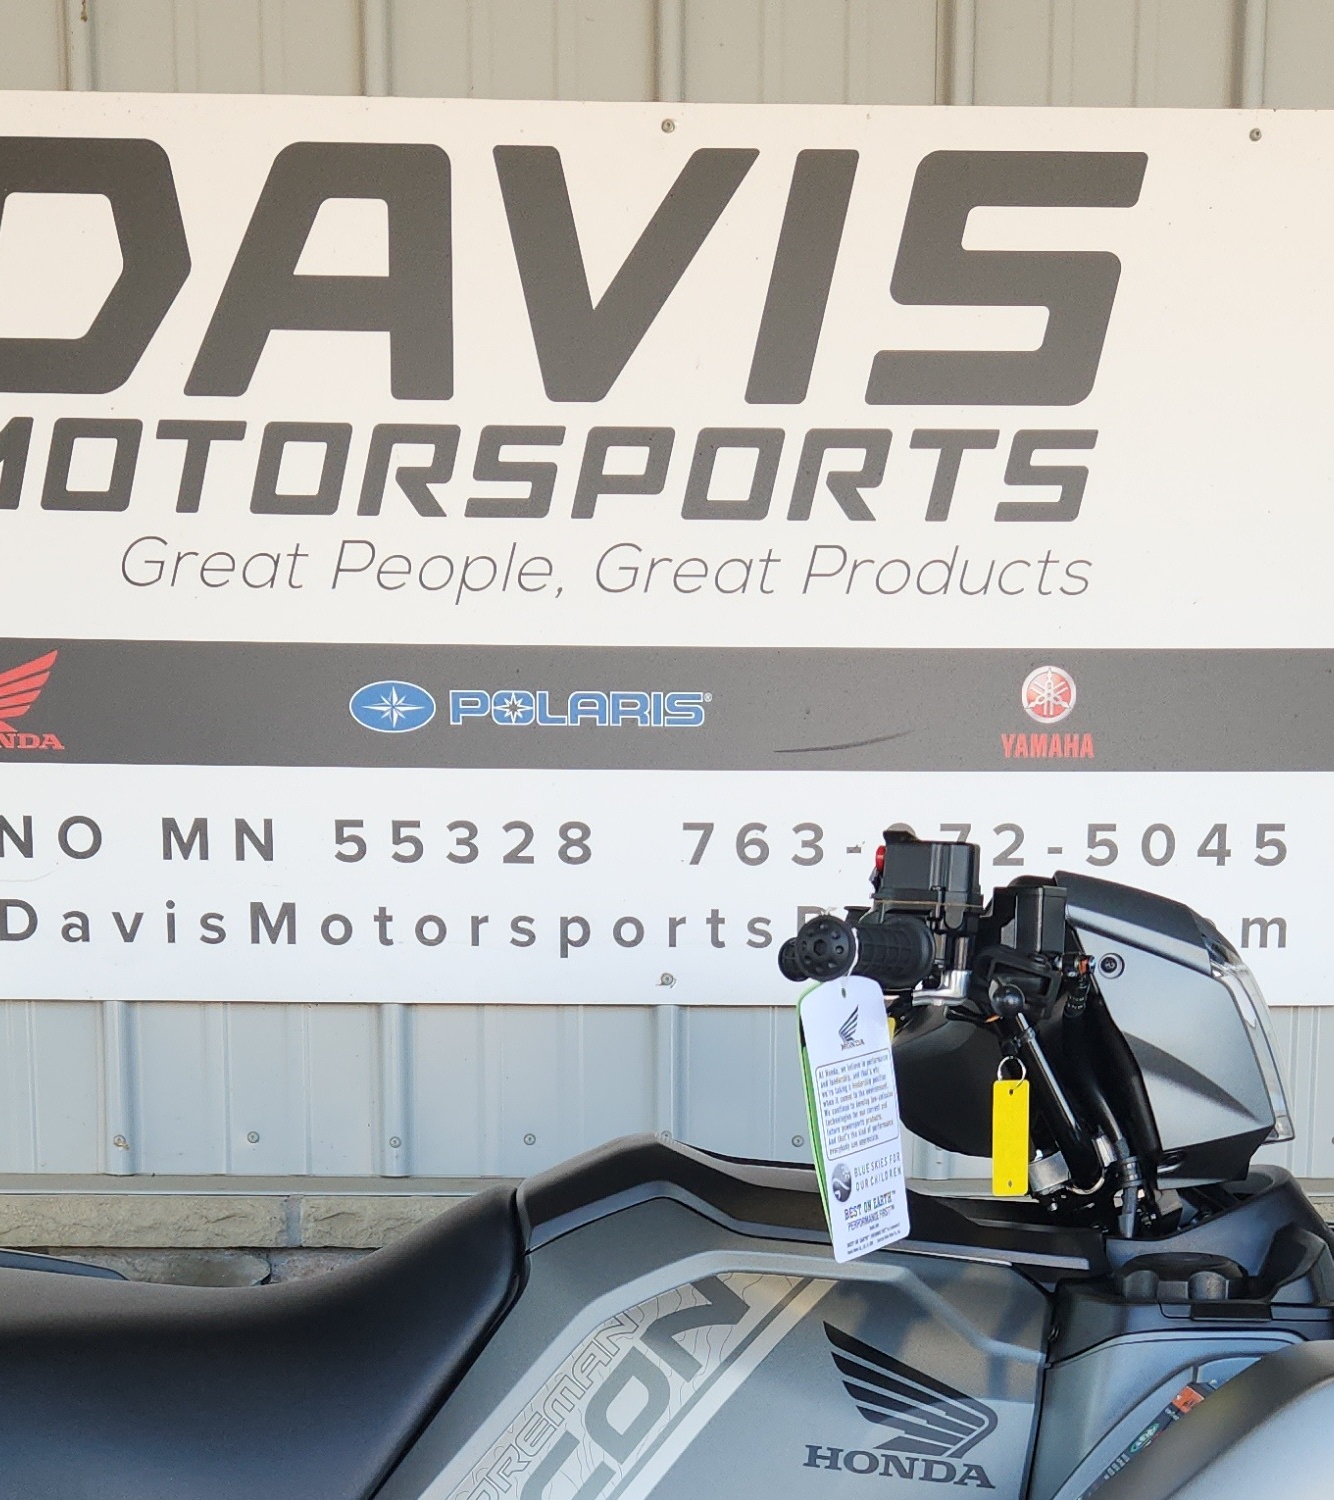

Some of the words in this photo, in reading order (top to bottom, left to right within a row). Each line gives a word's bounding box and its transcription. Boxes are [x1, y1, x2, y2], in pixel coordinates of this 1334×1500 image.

[122, 536, 309, 589] Great
[331, 539, 566, 605] People,
[597, 543, 781, 595] Great
[802, 545, 1092, 596] Products
[449, 690, 705, 727] POLARIS
[1000, 732, 1095, 758] YAMAHA
[162, 817, 274, 862] MN
[334, 820, 592, 865] 55328
[684, 822, 1287, 866] 763-72-5045
[803, 1443, 997, 1490] HONDA
